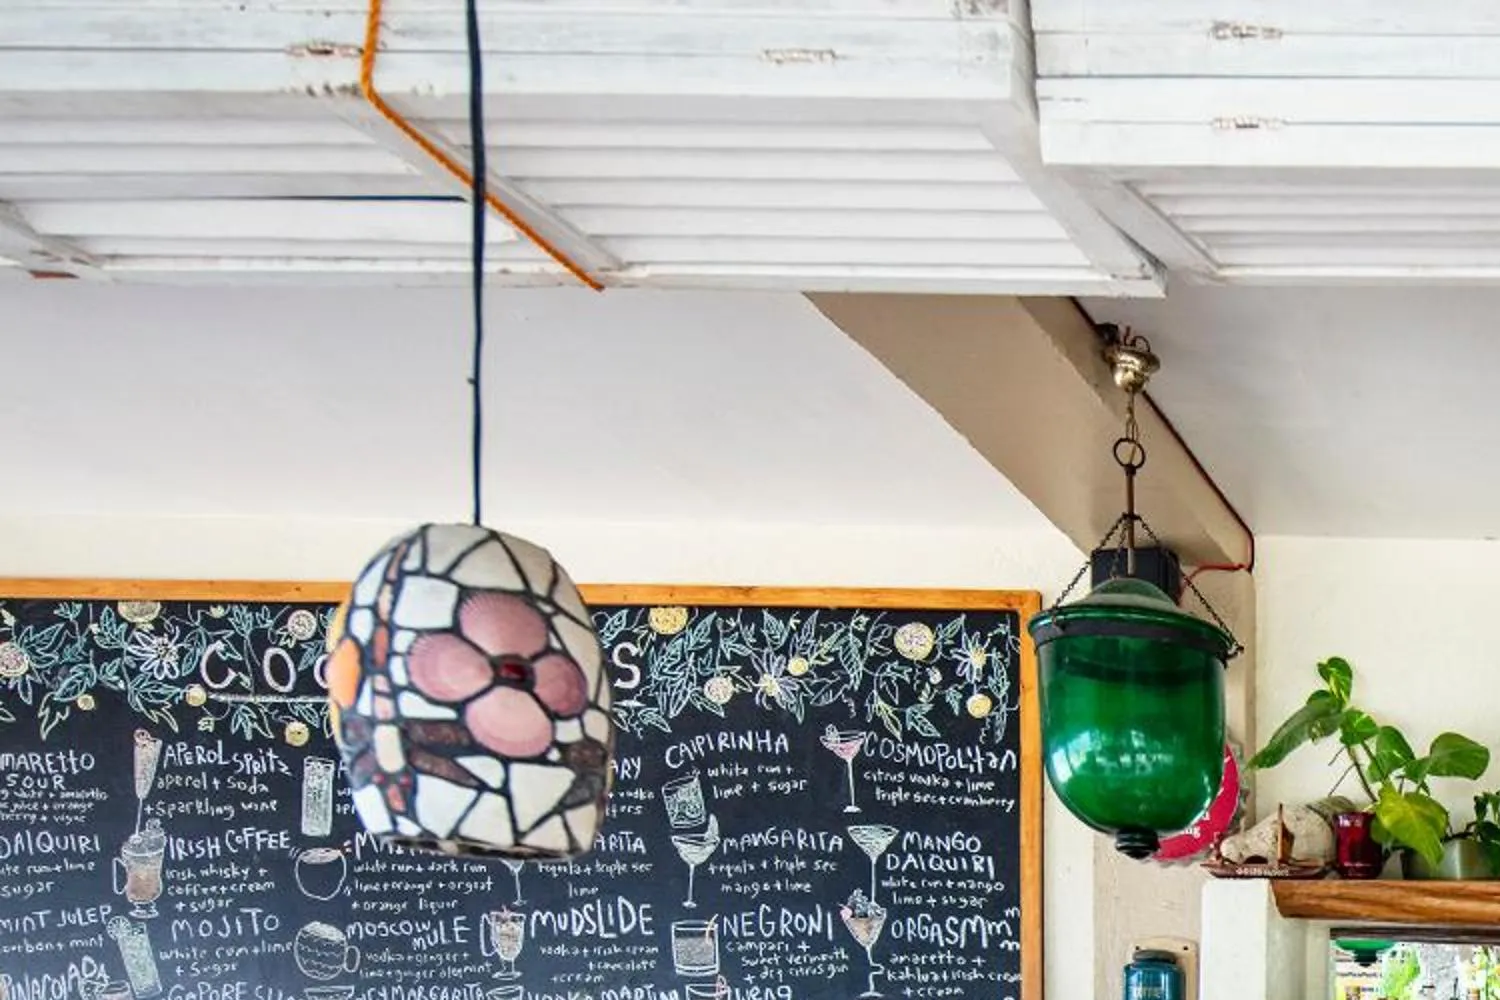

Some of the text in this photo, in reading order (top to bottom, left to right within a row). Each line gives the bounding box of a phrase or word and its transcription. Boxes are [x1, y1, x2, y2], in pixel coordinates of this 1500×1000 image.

[665, 730, 789, 768] CAIPIRINHA
[7, 775, 64, 789] SOUR
[902, 831, 981, 853] MANGO
[886, 853, 994, 880] DAIQUIRI
[57, 905, 111, 927] JULEP
[172, 908, 279, 941] MOJITO
[531, 896, 654, 939] MUDSLIDE
[722, 903, 834, 941] NEGRONI
